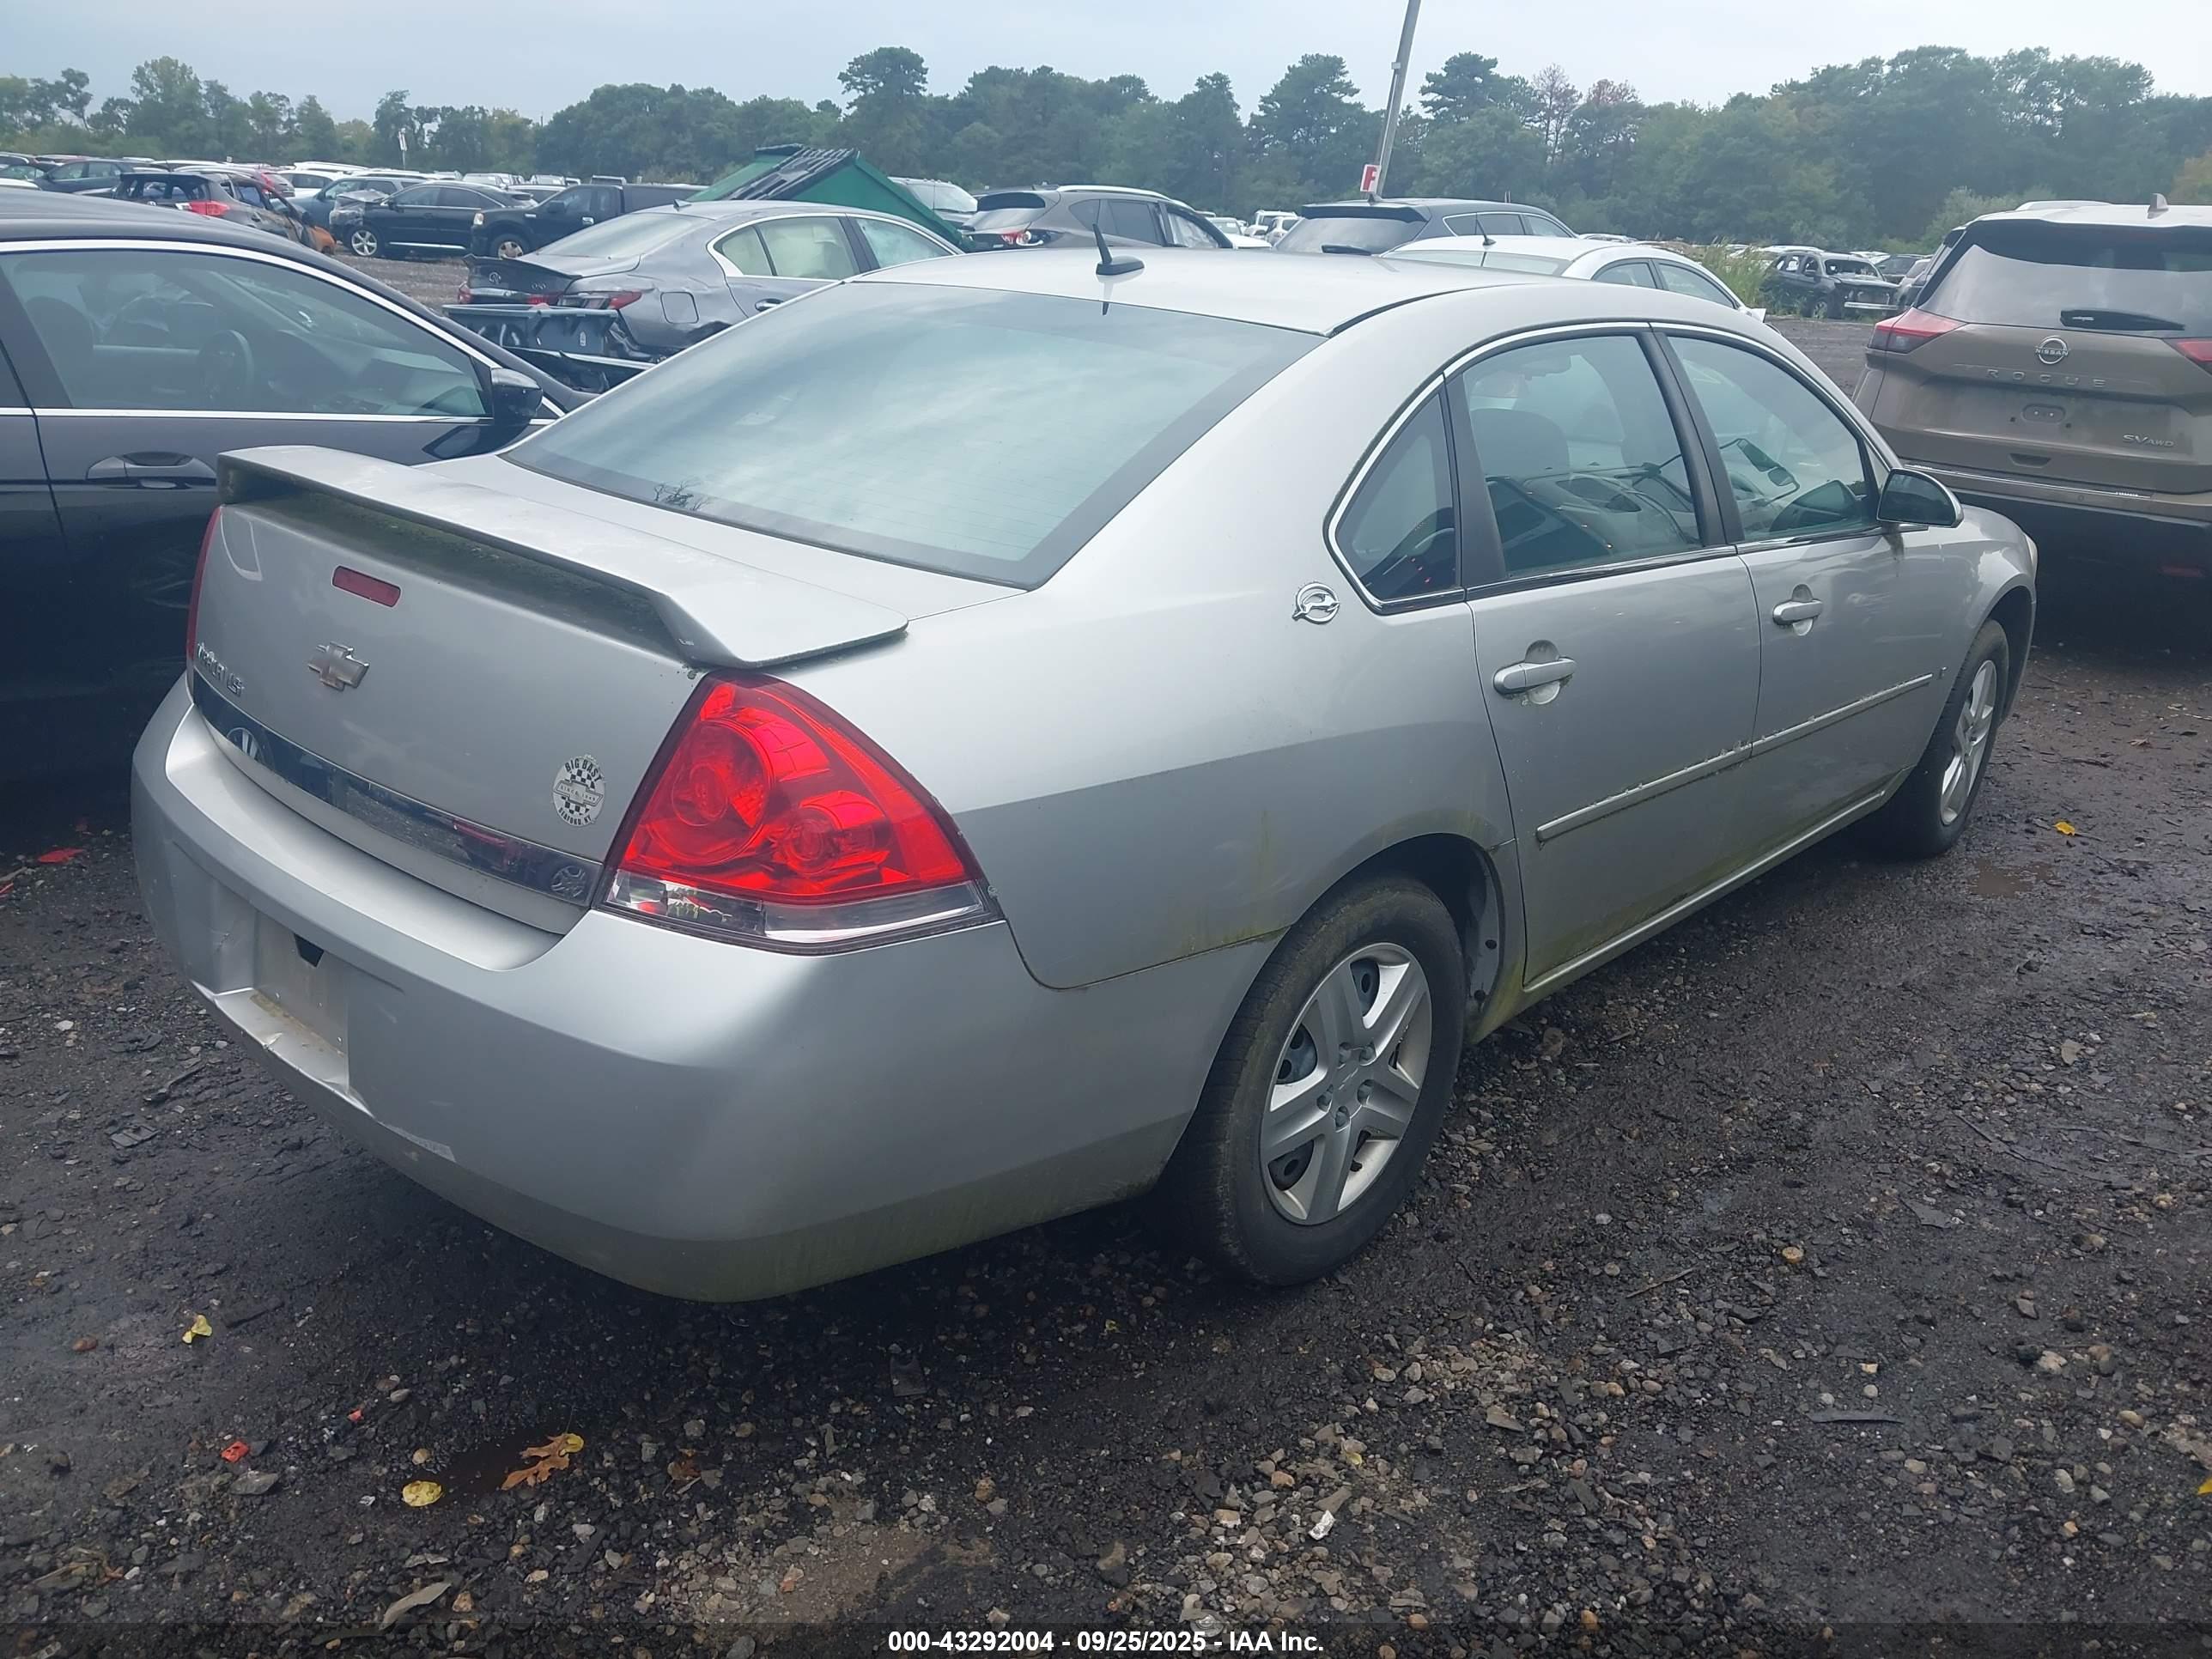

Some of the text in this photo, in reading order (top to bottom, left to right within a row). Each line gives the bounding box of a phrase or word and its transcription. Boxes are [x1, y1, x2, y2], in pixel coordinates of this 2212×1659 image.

[1363, 166, 1376, 190] F
[2035, 347, 2069, 357] NISSAN
[1987, 368, 2106, 387] ROGUE
[2123, 434, 2148, 443] SV
[565, 758, 580, 772] BIG
